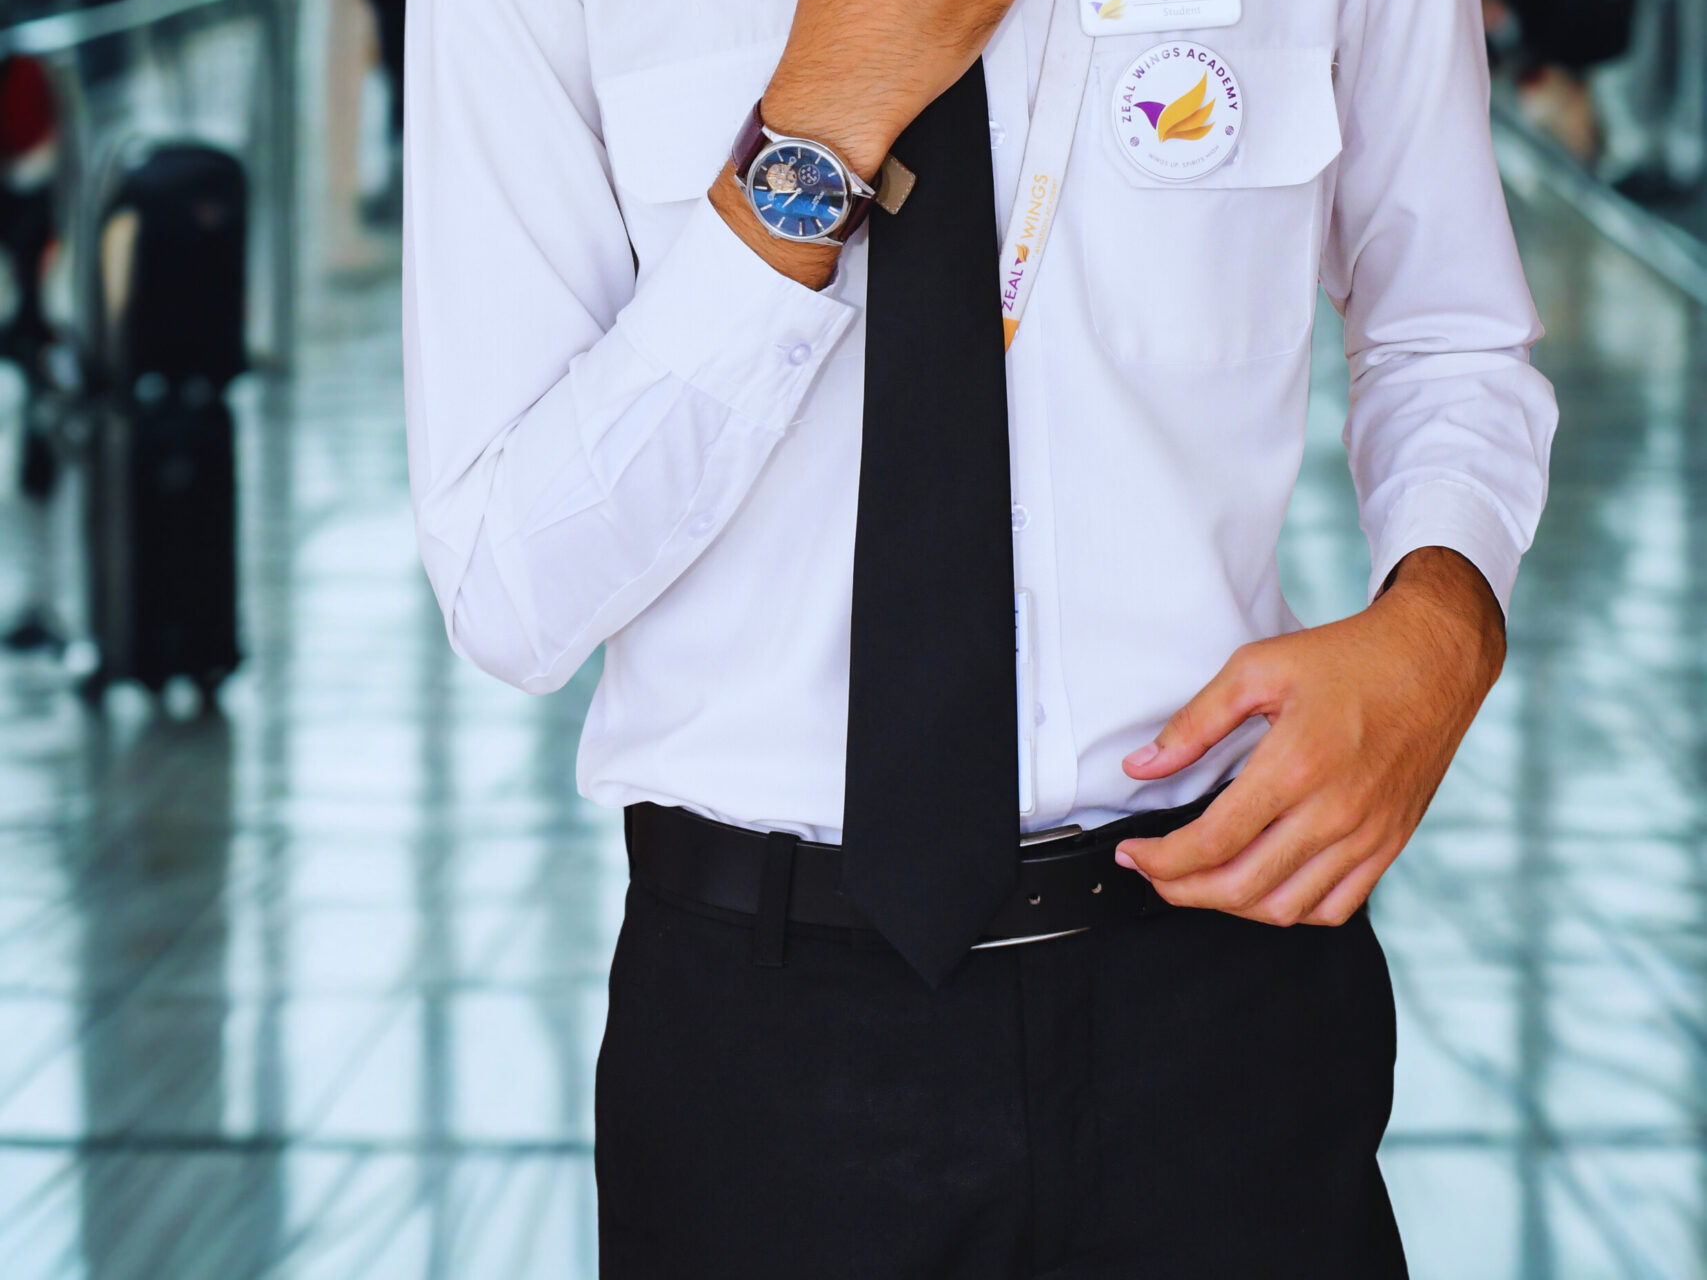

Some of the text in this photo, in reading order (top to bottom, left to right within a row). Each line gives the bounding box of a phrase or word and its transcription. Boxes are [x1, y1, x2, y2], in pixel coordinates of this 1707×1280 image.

[1162, 6, 1201, 17] Student
[1121, 47, 1238, 123] ZEAL WINGS ACADEMY
[1001, 269, 1024, 312] ZEAL
[1020, 174, 1049, 239] WINGS
